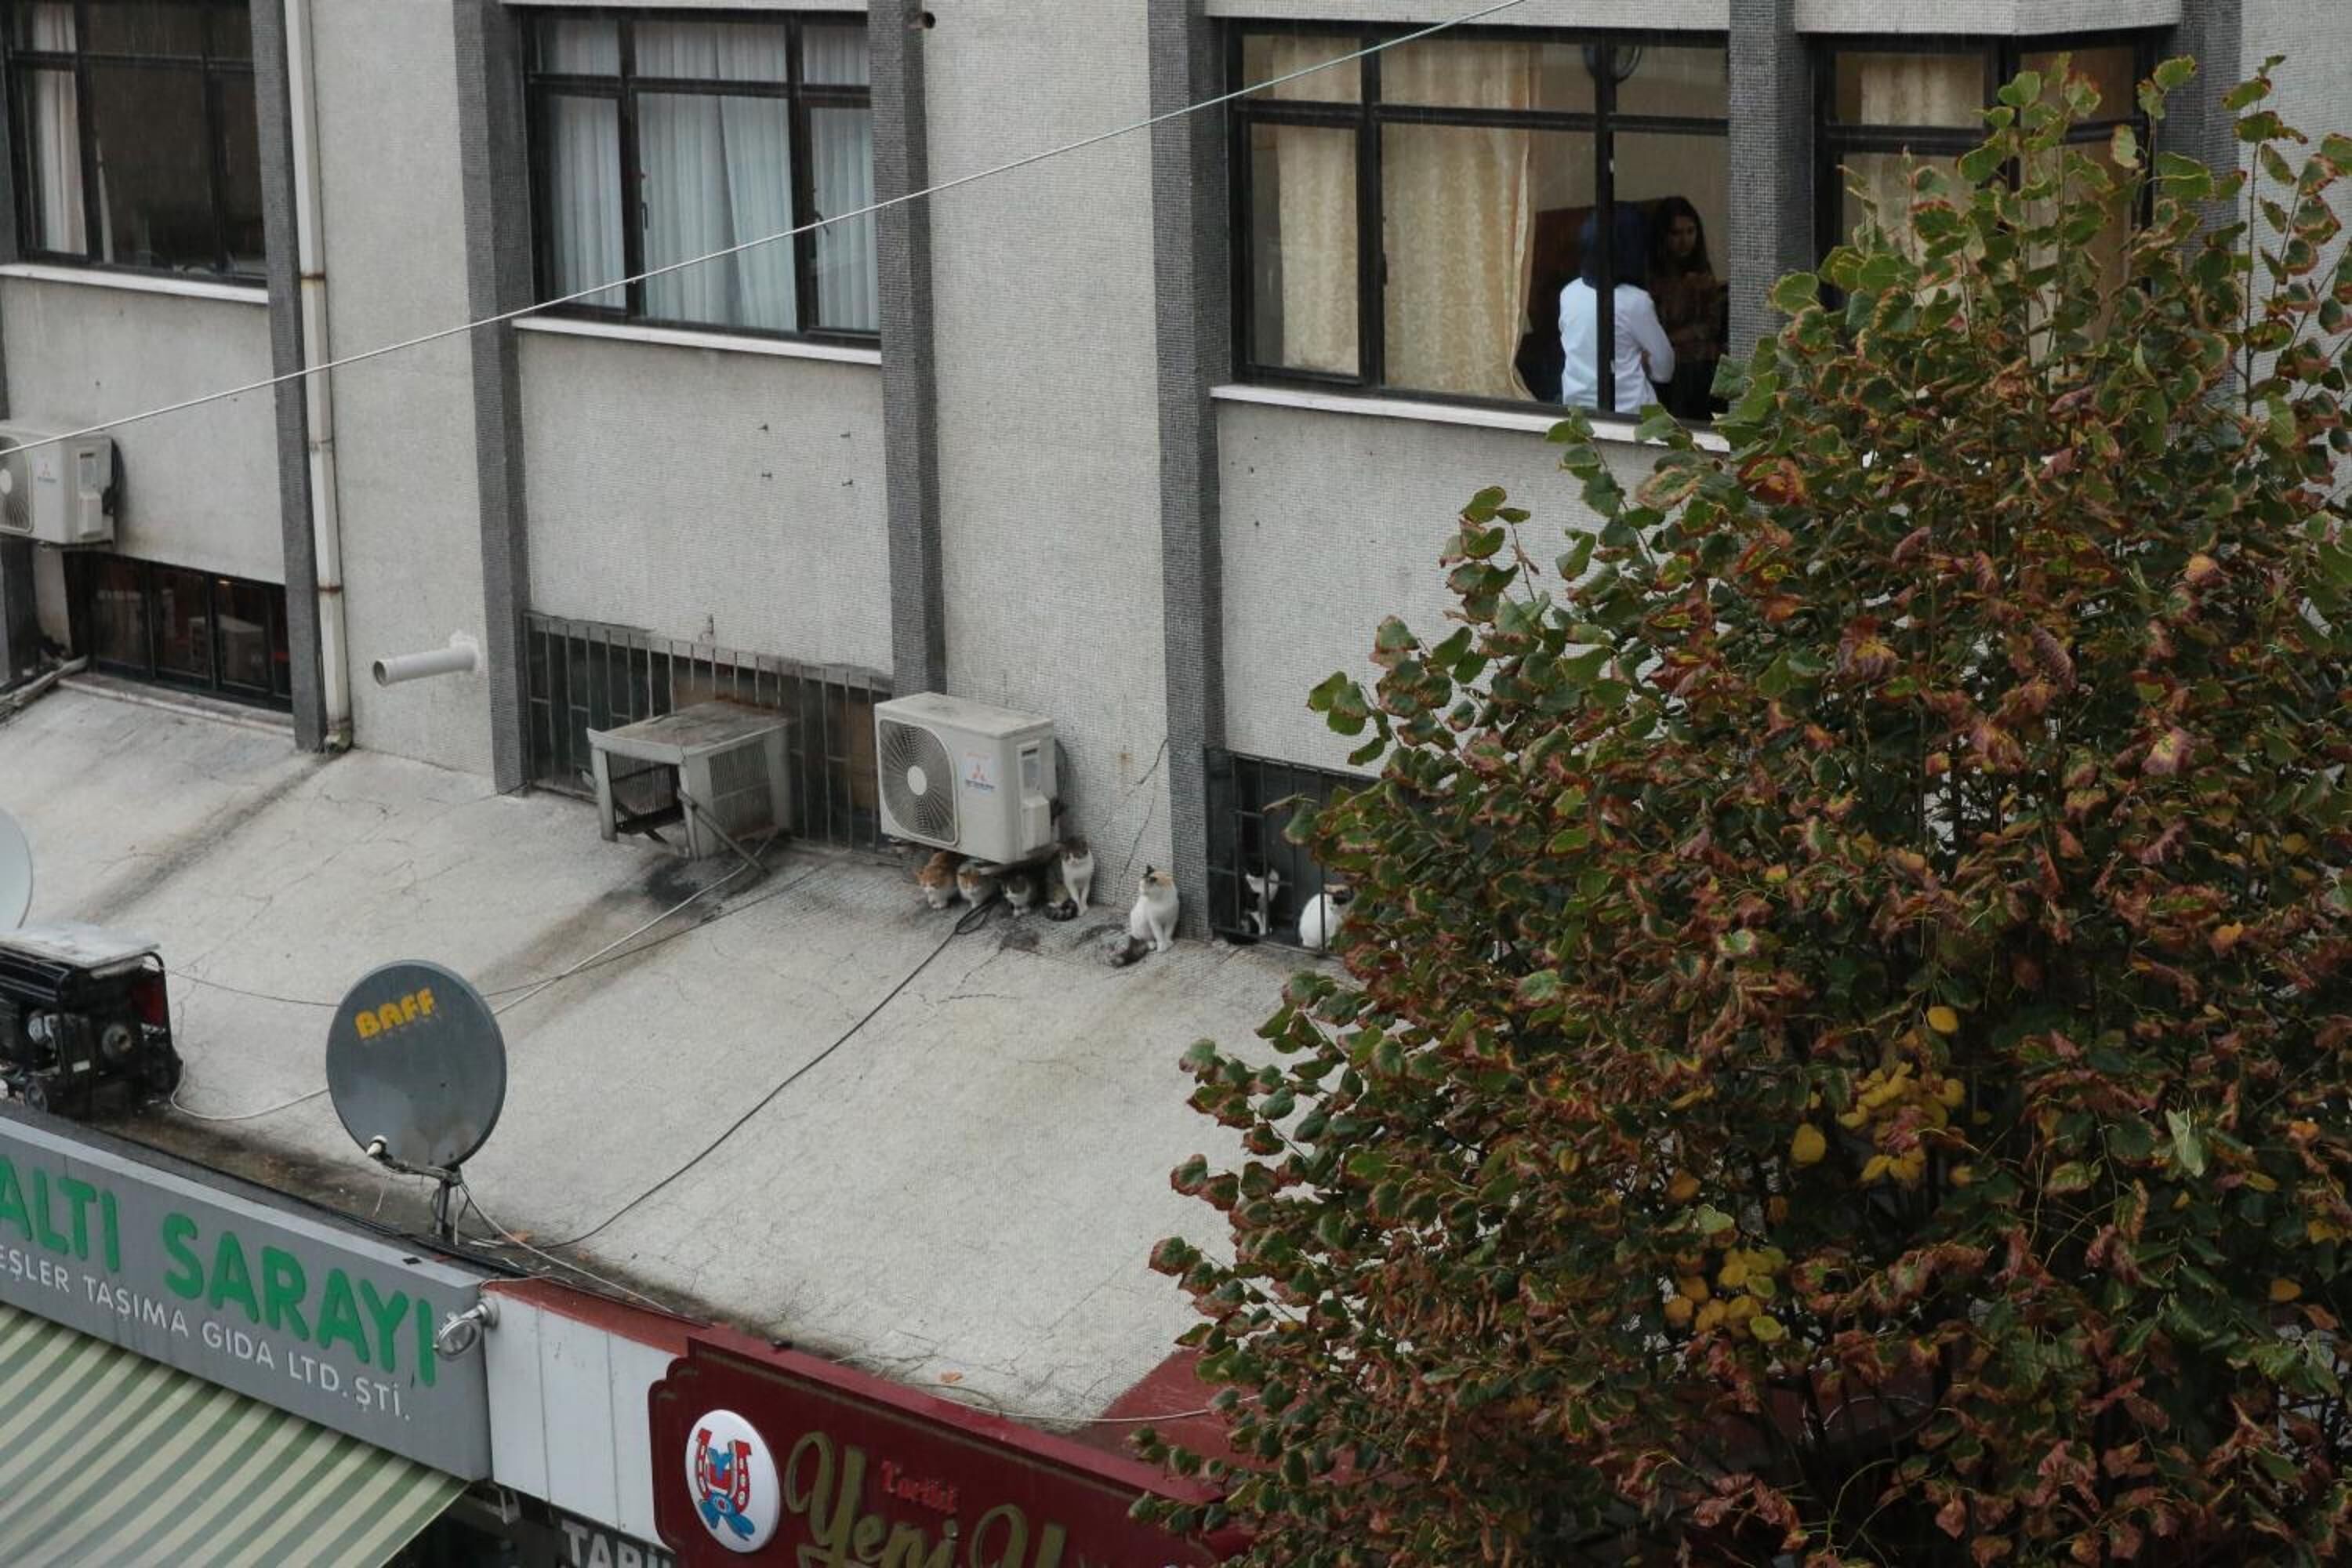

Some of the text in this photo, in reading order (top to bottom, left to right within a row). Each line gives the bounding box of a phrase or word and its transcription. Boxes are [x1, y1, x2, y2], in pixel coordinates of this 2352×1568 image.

[83, 1276, 189, 1338] TAŞIMA
[201, 1321, 274, 1369] GIDA
[162, 1212, 436, 1388] SARAYI
